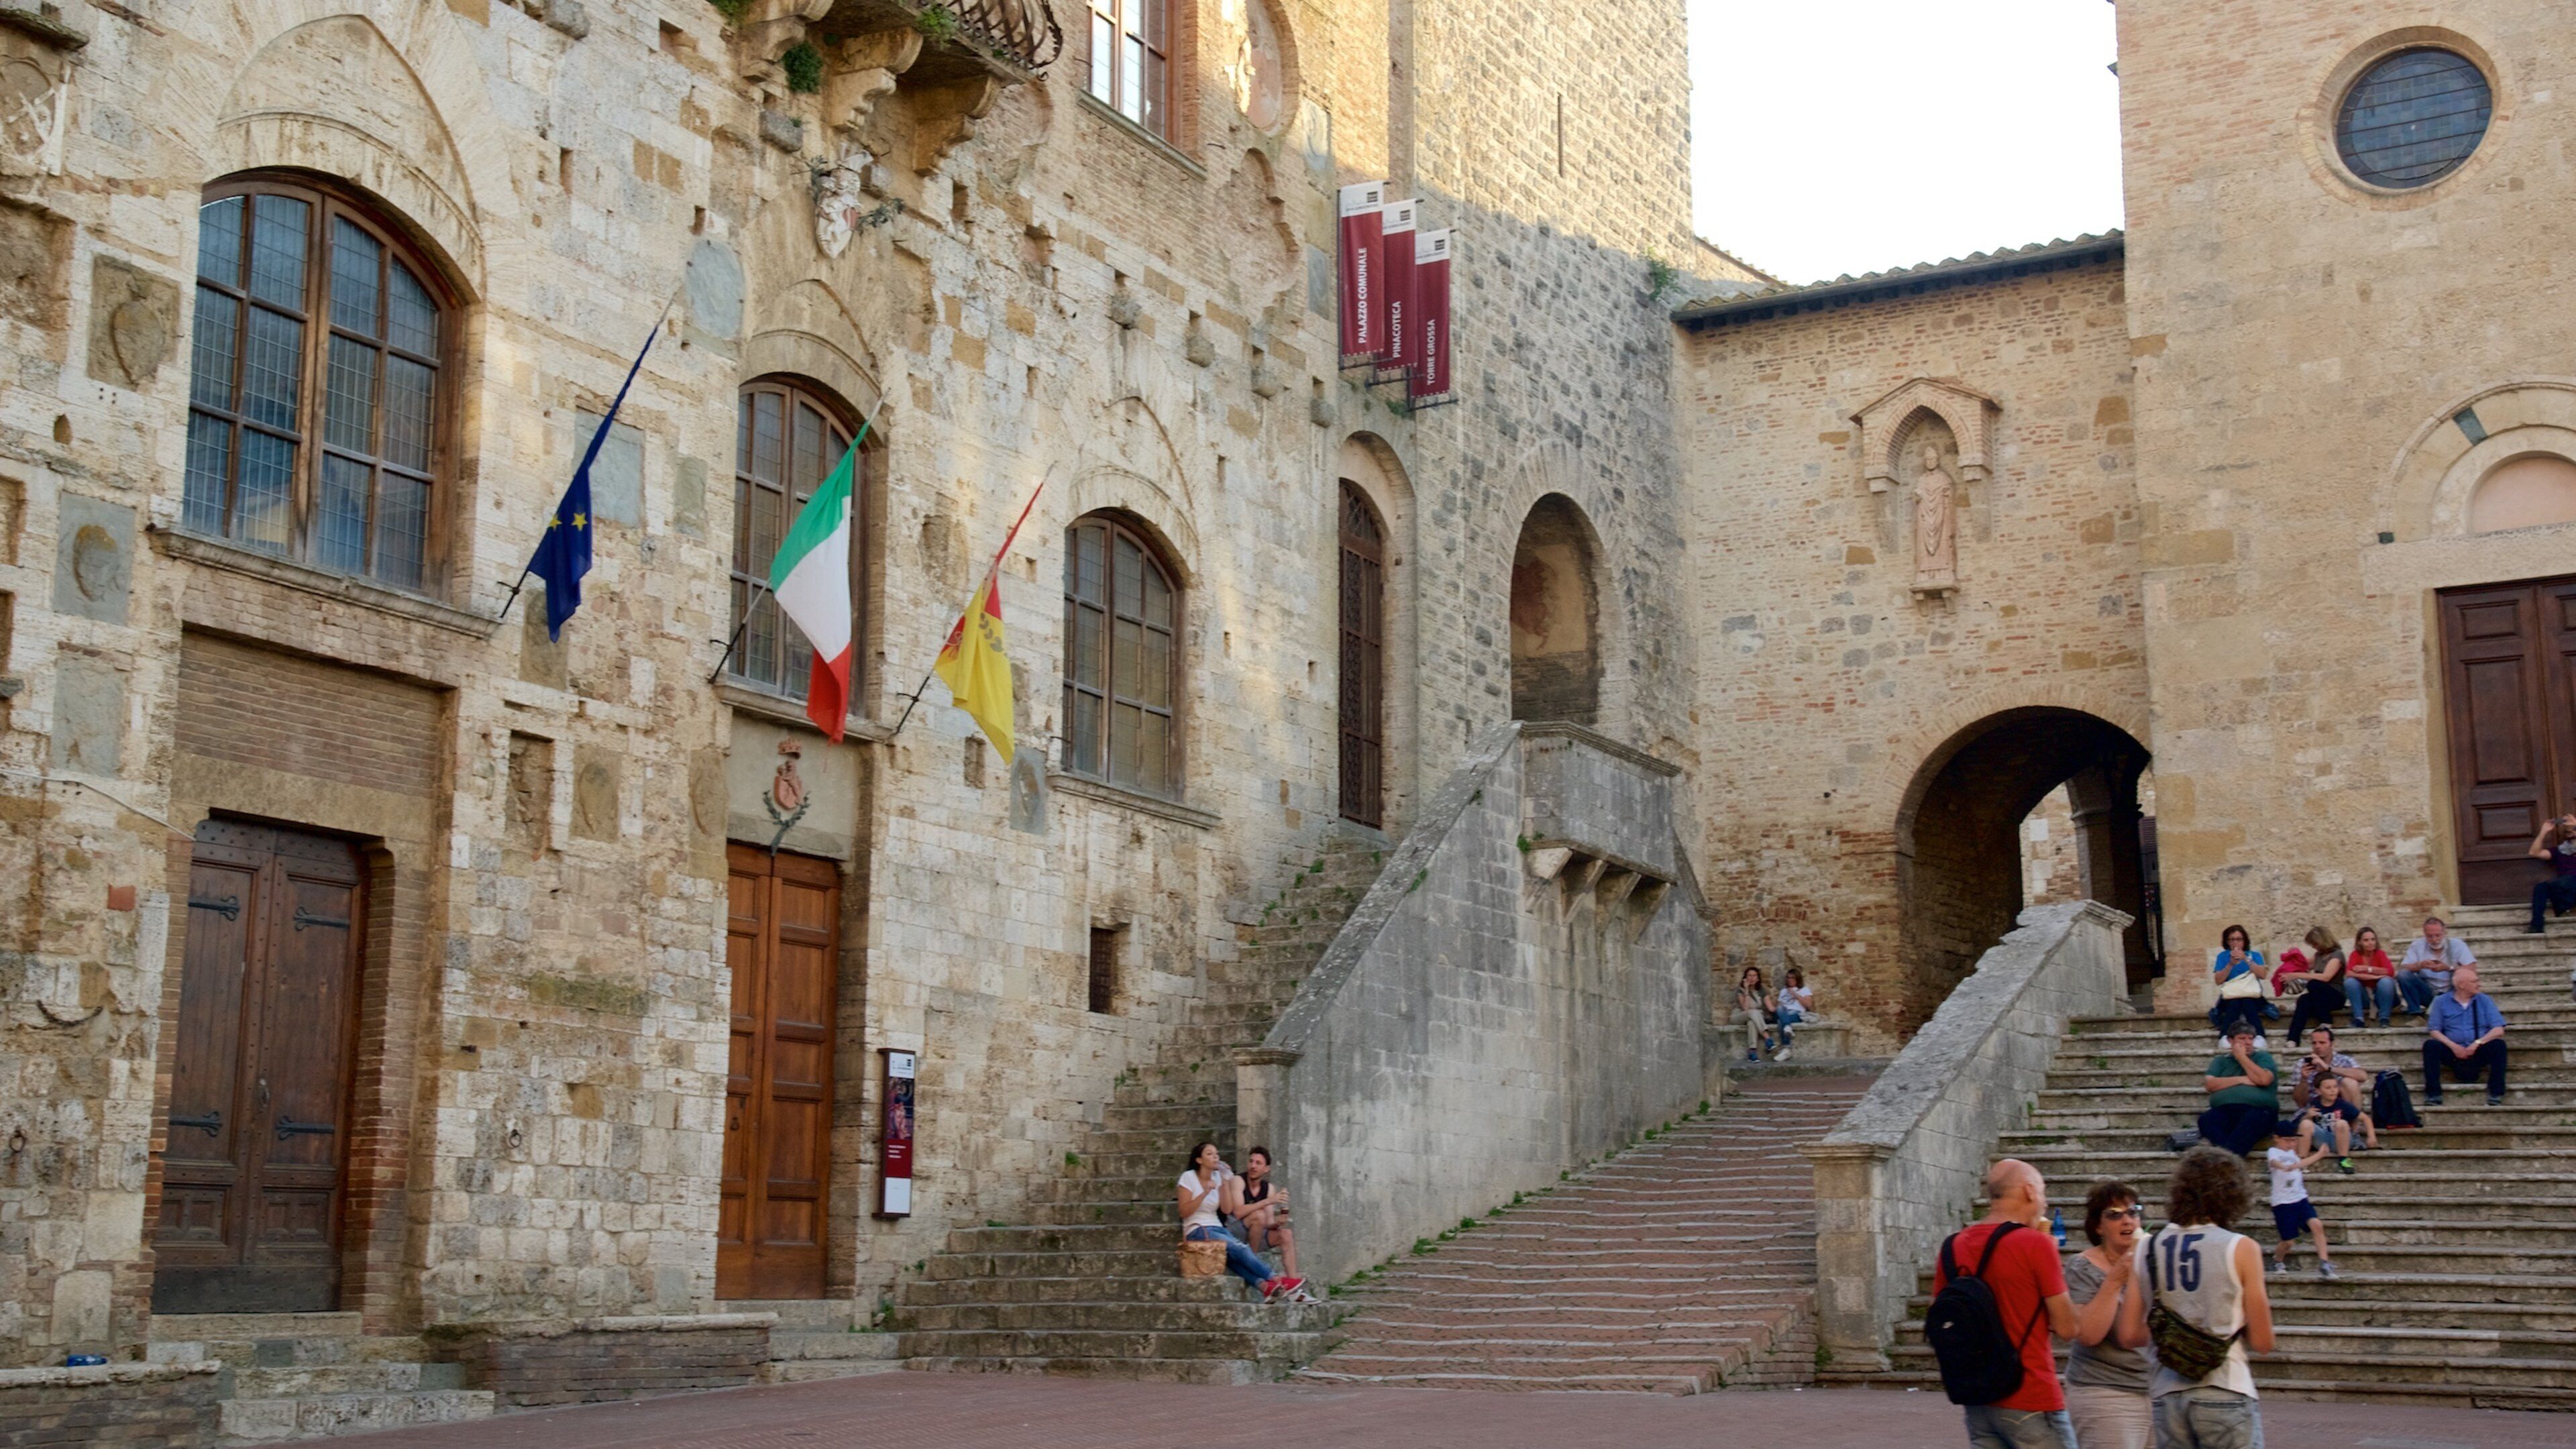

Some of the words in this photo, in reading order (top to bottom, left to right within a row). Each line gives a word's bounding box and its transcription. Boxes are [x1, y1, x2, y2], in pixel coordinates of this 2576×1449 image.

[1358, 248, 1368, 298] COMUNALE
[1358, 300, 1368, 343] PALAZZO
[1393, 301, 1401, 358] PINACOTECA
[1427, 319, 1436, 354] GROSSA
[1427, 356, 1436, 385] TORRE
[2161, 1234, 2205, 1291] 15
